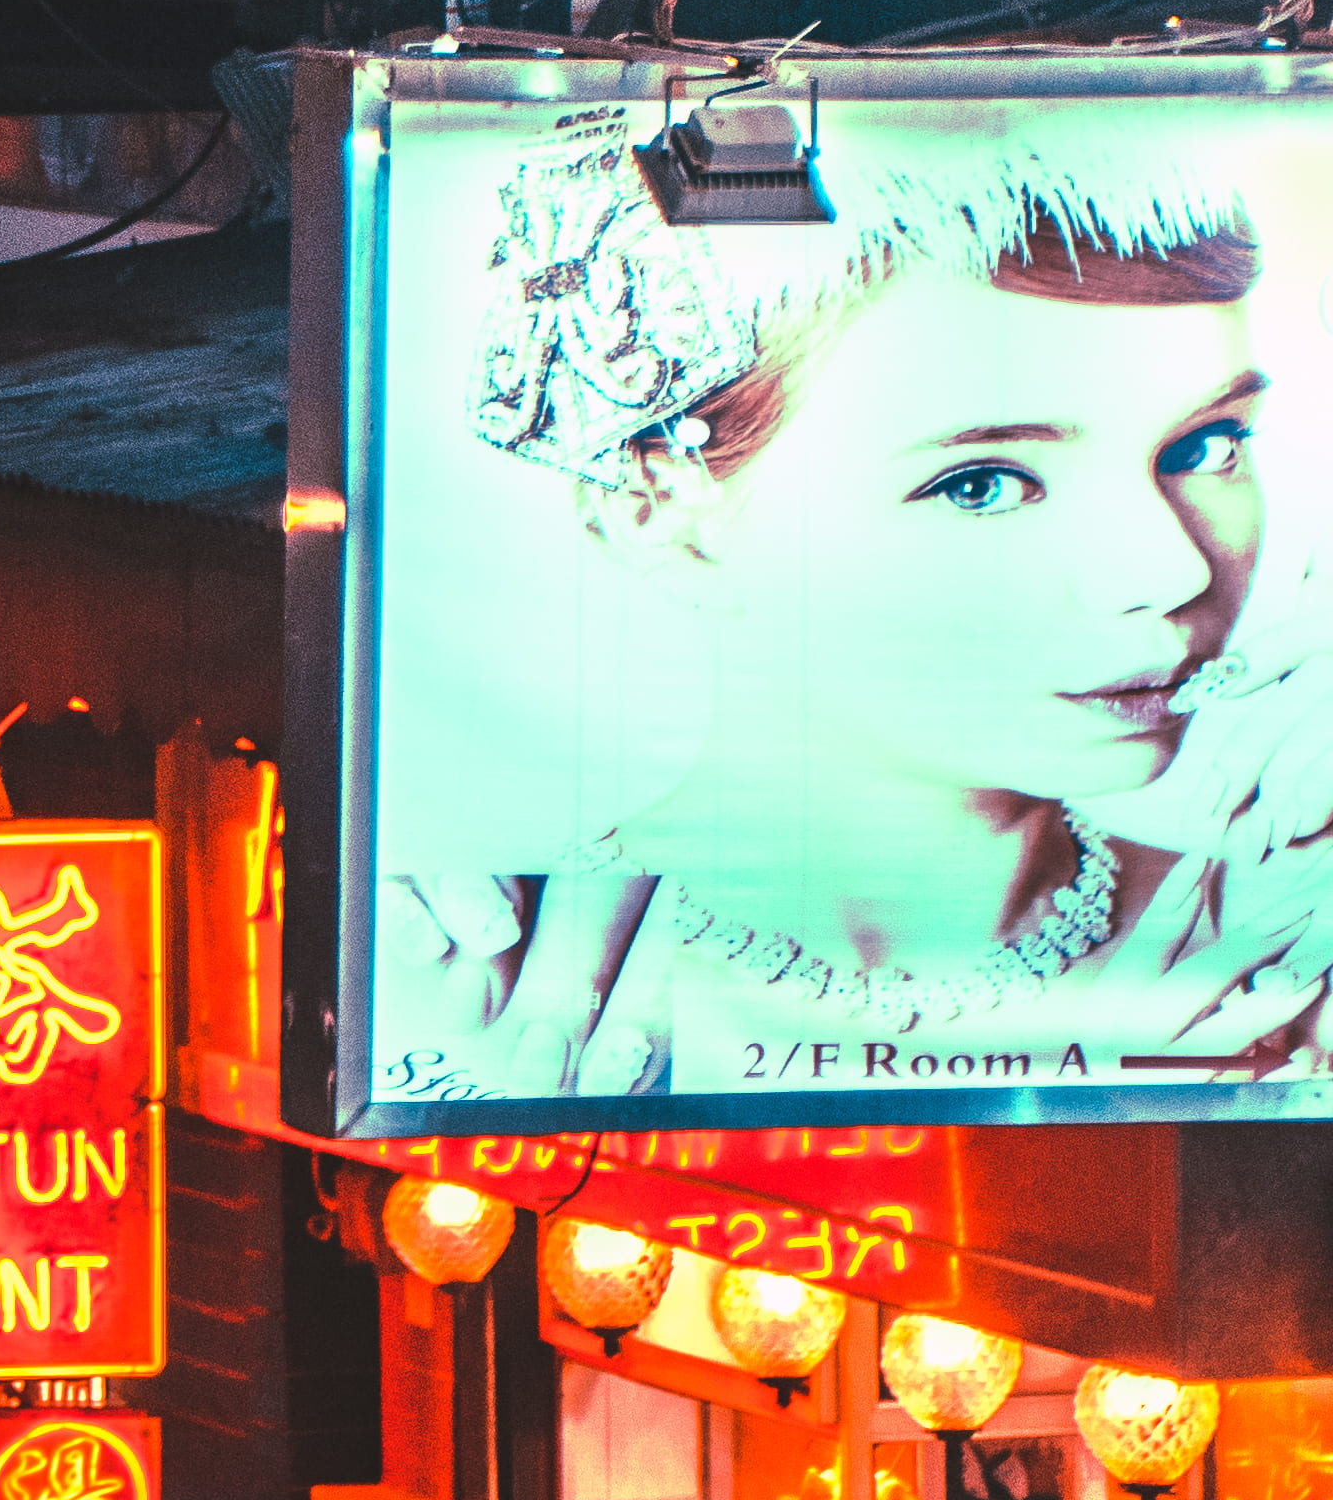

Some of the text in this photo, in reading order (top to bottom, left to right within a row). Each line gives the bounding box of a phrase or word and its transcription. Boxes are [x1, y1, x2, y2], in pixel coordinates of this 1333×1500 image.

[743, 1041, 1092, 1079] 2/F Room A
